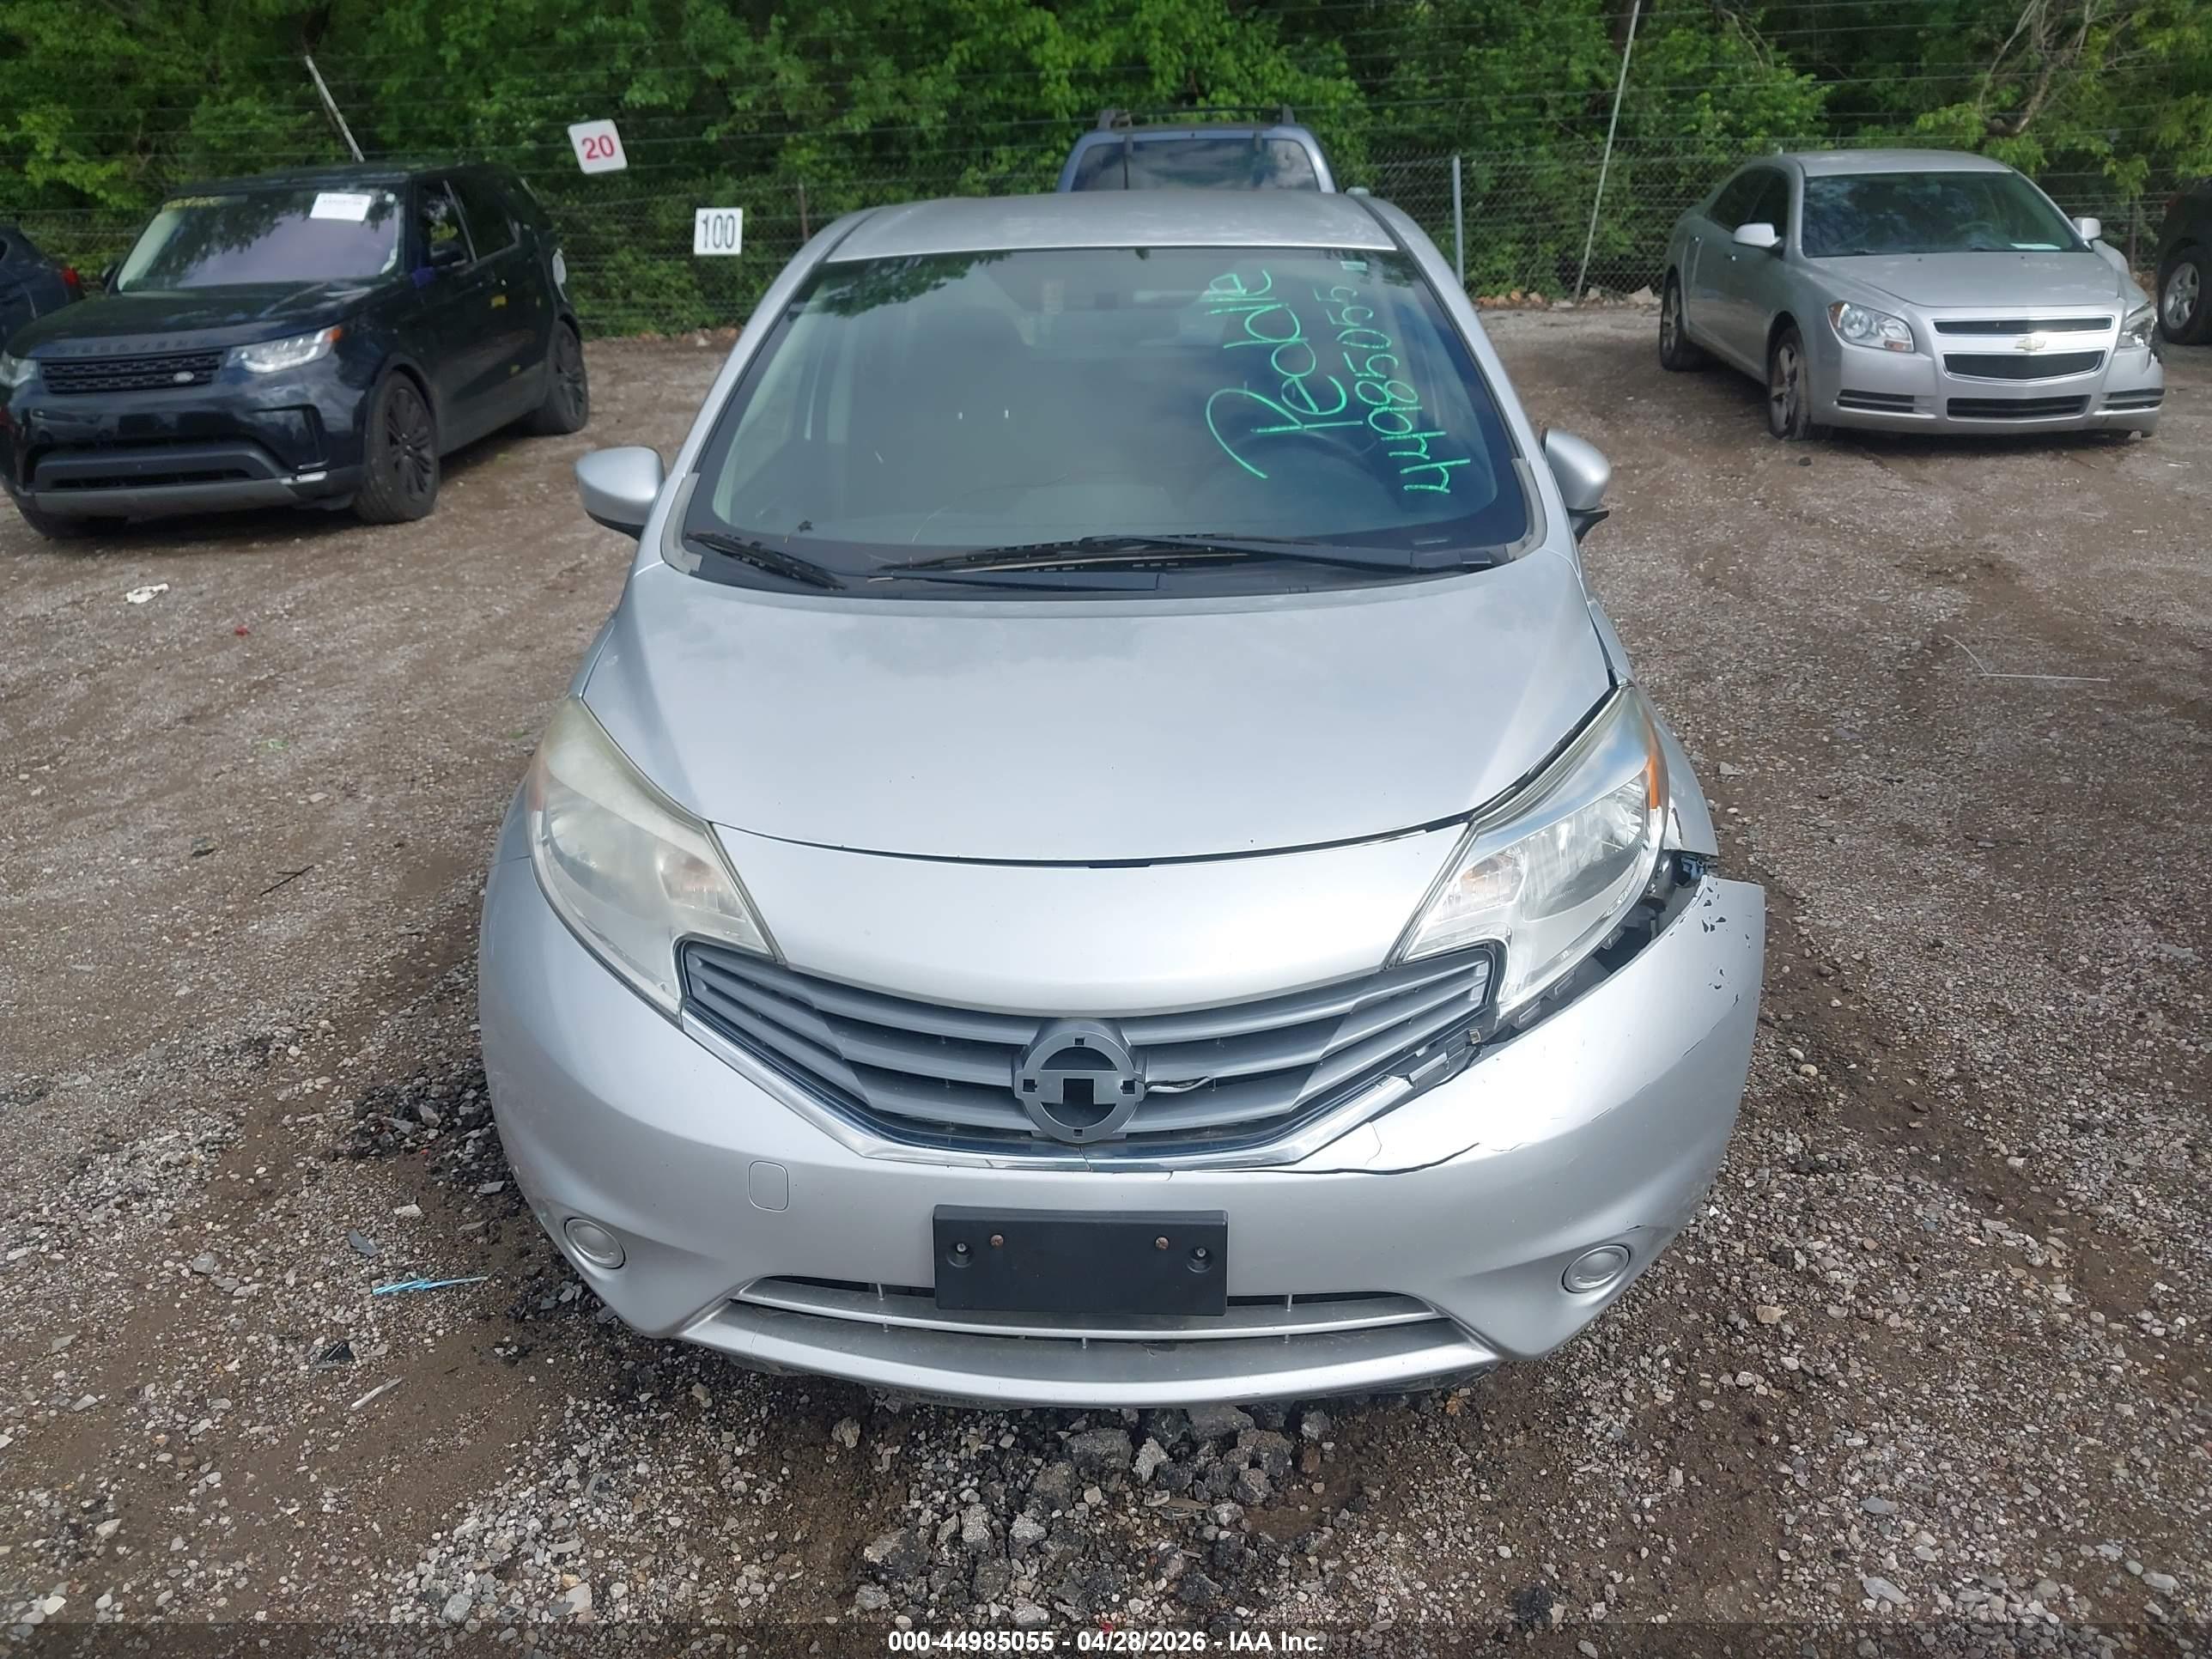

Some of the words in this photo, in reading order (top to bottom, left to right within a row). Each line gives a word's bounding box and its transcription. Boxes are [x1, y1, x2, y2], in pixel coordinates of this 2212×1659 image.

[581, 135, 615, 161] 20
[702, 214, 735, 249] 100
[1314, 286, 1471, 495] 44985055
